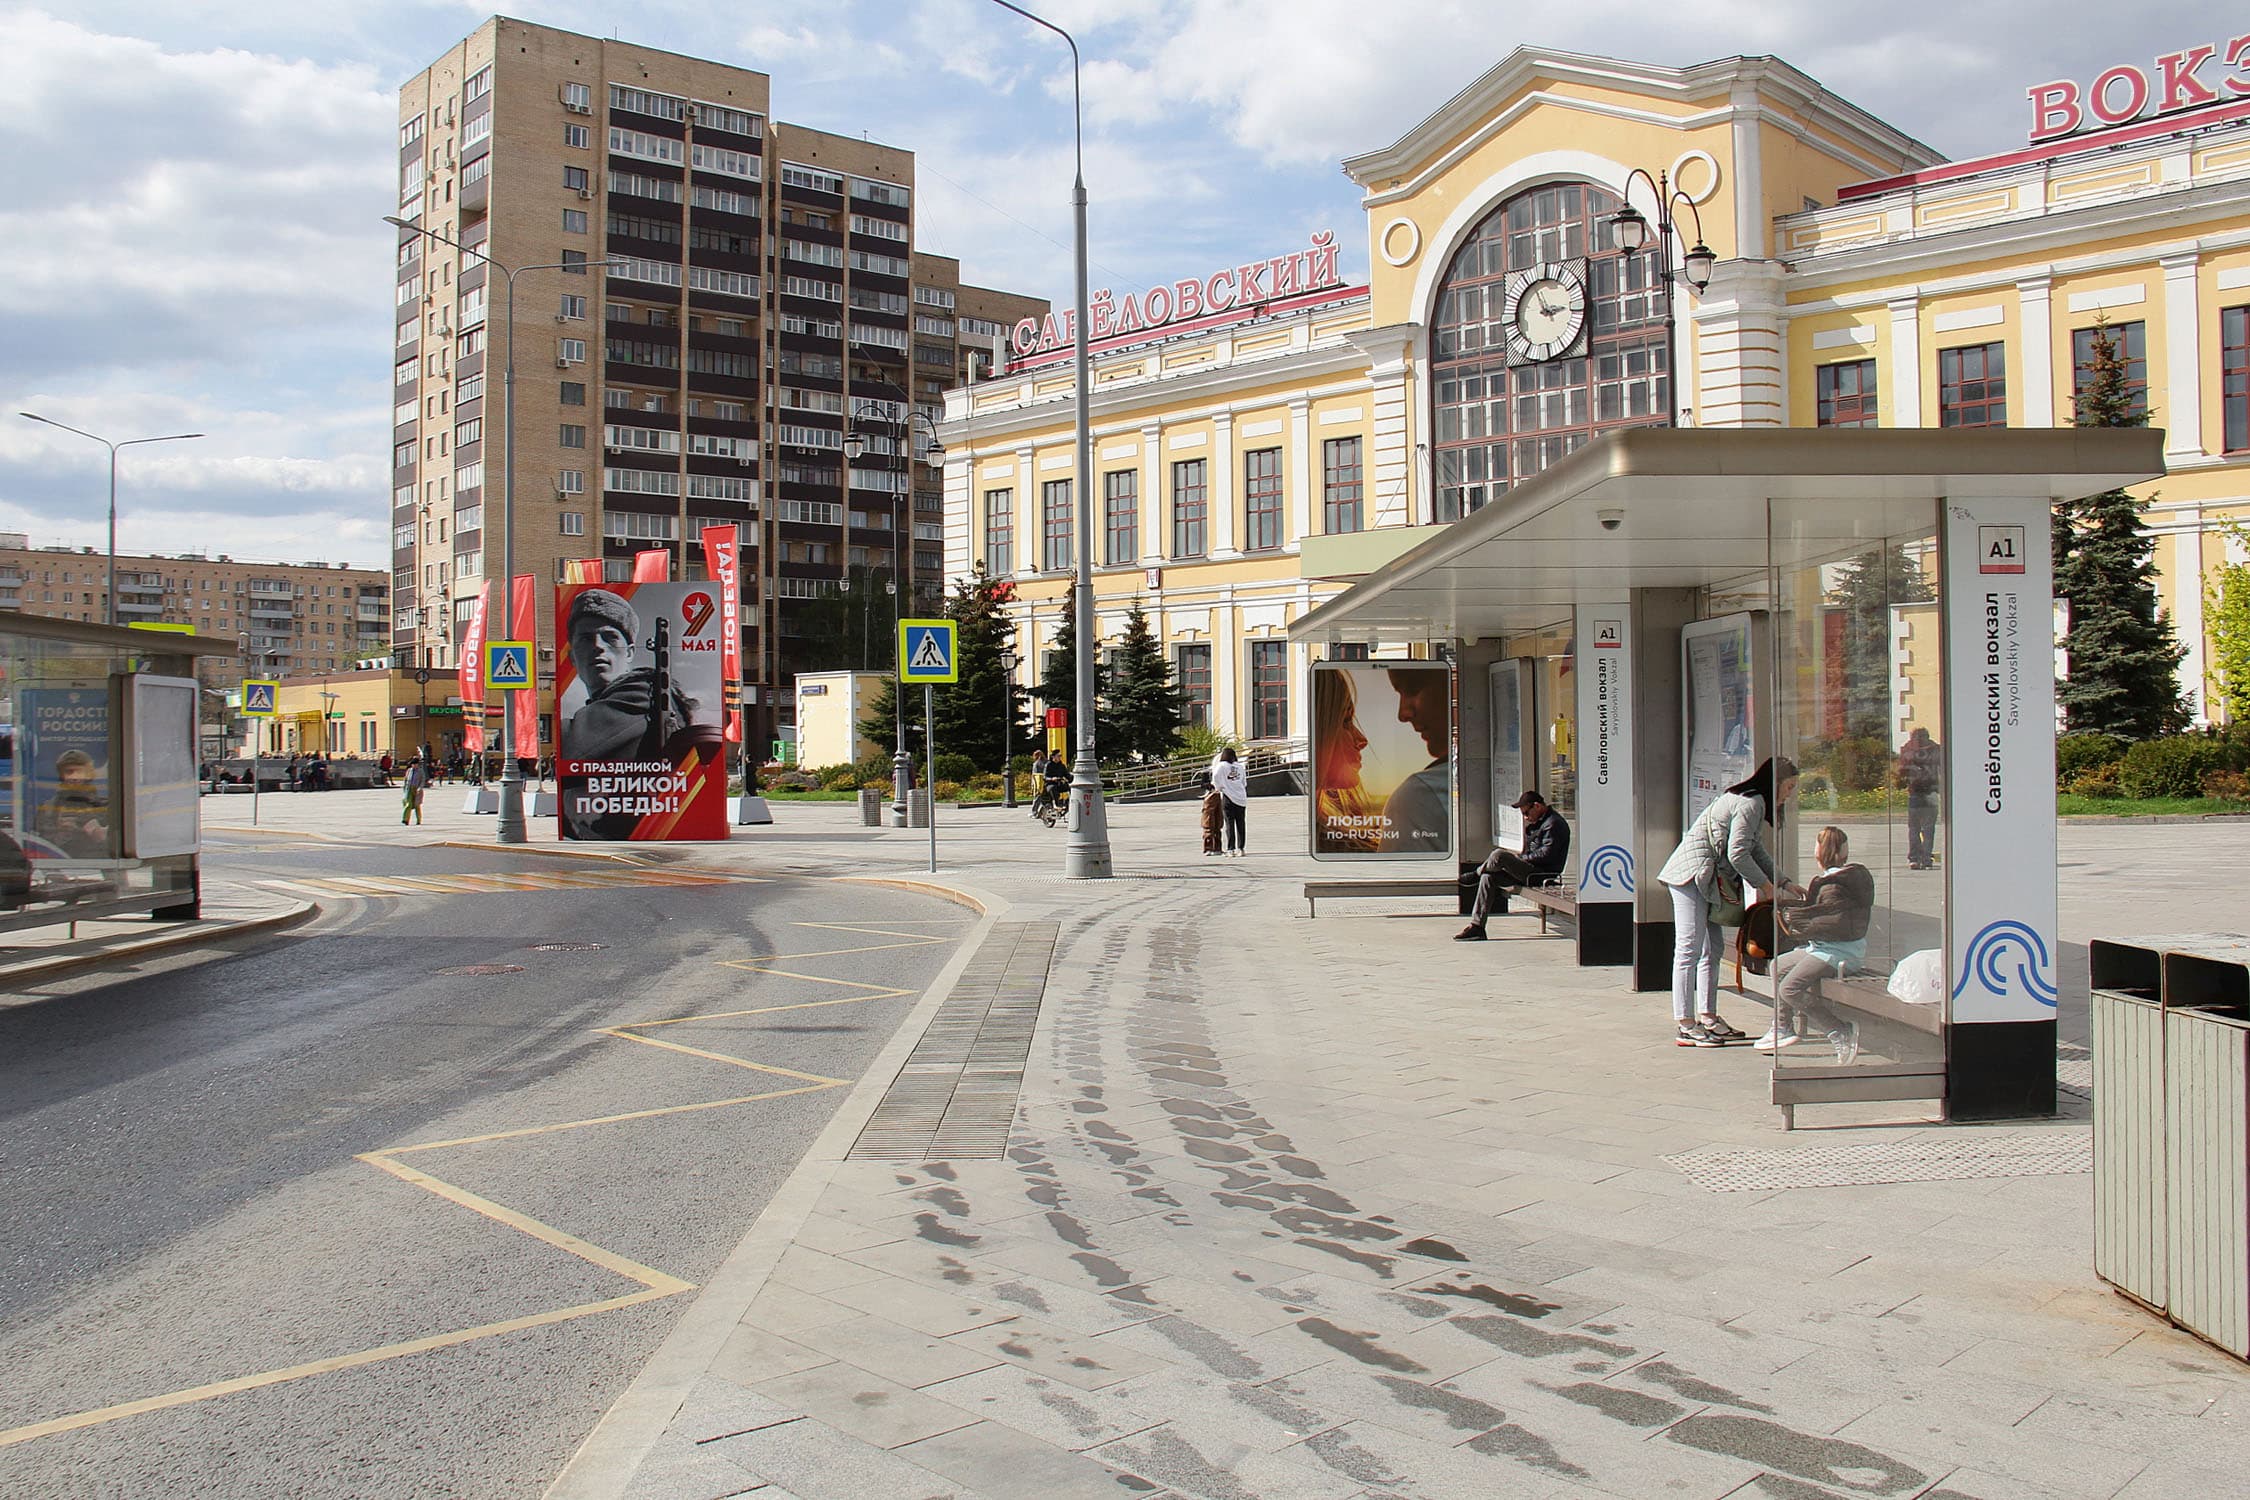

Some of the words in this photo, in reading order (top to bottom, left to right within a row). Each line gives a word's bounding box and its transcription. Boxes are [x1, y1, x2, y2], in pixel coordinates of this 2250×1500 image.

[1984, 592, 2000, 665] вокзал
[2005, 592, 2019, 638] Vokzal
[682, 639, 716, 652] МАЯ
[1598, 658, 1608, 701] вокзал
[2006, 640, 2021, 727] Savyolovskiy
[1597, 704, 1609, 786] Савёловский
[1984, 672, 2001, 814] Савёловский
[570, 762, 580, 773] С
[583, 761, 672, 774] ПРАЗДНИКОМ
[588, 771, 687, 793] ВЕЛИКОЙ
[576, 797, 679, 816] ПОБЕДЫ!
[1326, 815, 1393, 827] ЛЮБИТЬ
[1326, 829, 1399, 840] по-RUSSки
